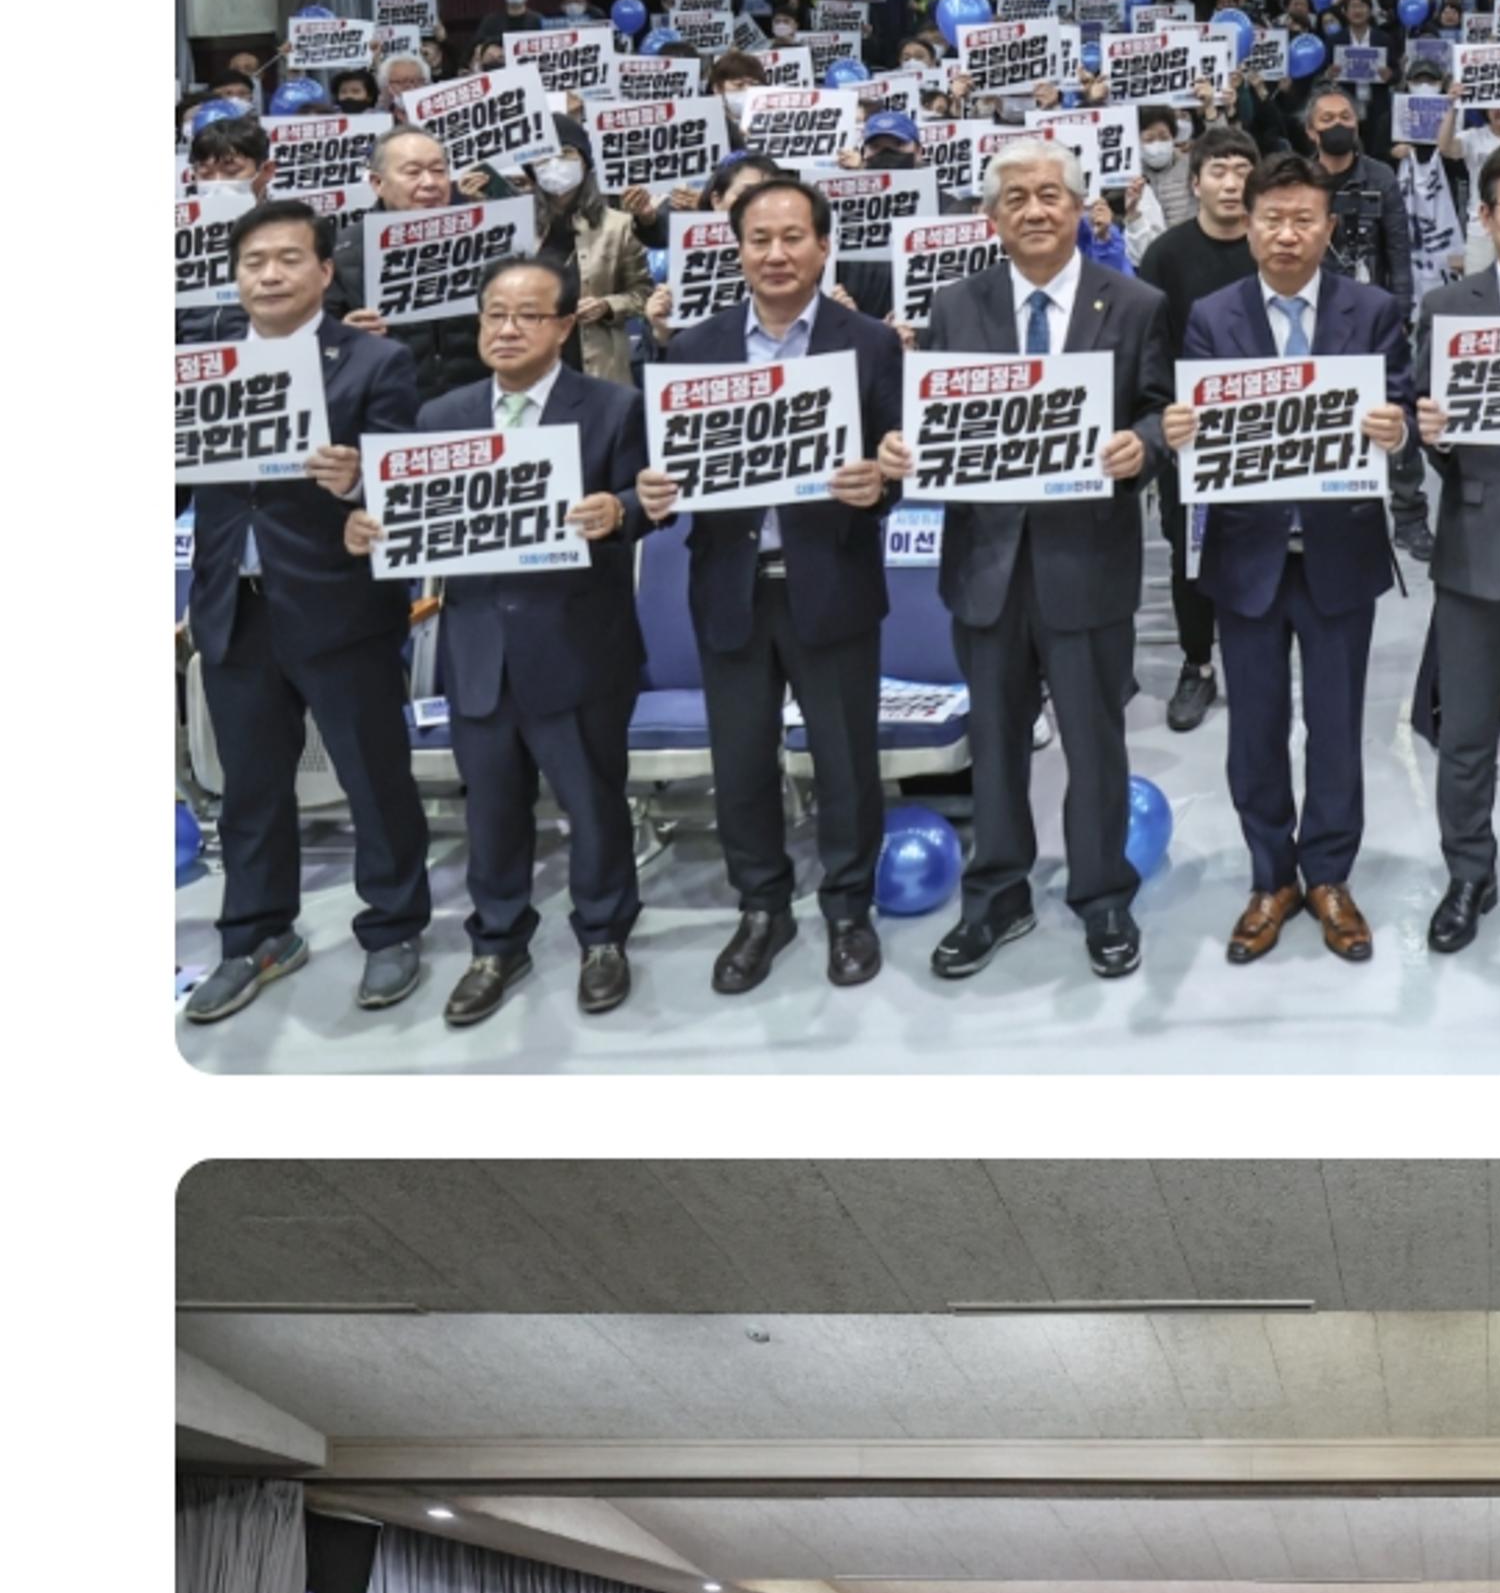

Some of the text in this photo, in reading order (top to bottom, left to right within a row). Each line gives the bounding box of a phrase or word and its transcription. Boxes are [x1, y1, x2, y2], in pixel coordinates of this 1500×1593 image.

[450, 113, 542, 170] 탄한다!
[602, 119, 706, 158] 친일야합
[606, 145, 719, 187] 규탄한다!
[380, 223, 516, 284] 친일야합
[670, 369, 772, 408] 윤석열정권
[928, 363, 1031, 396] 윤석열정권
[1202, 366, 1304, 403] 윤석열정권
[662, 387, 832, 456] 친일야합
[917, 387, 1087, 445] 친일야합
[1195, 388, 1360, 448] 친일야합
[388, 441, 493, 479] 윤석열정권
[663, 427, 847, 498] 규탄한다!
[916, 427, 1099, 490] 규탄한다!
[1194, 432, 1370, 492] 규탄한다!
[383, 462, 552, 525] 친일야합
[385, 501, 569, 567] 규탄한다!
